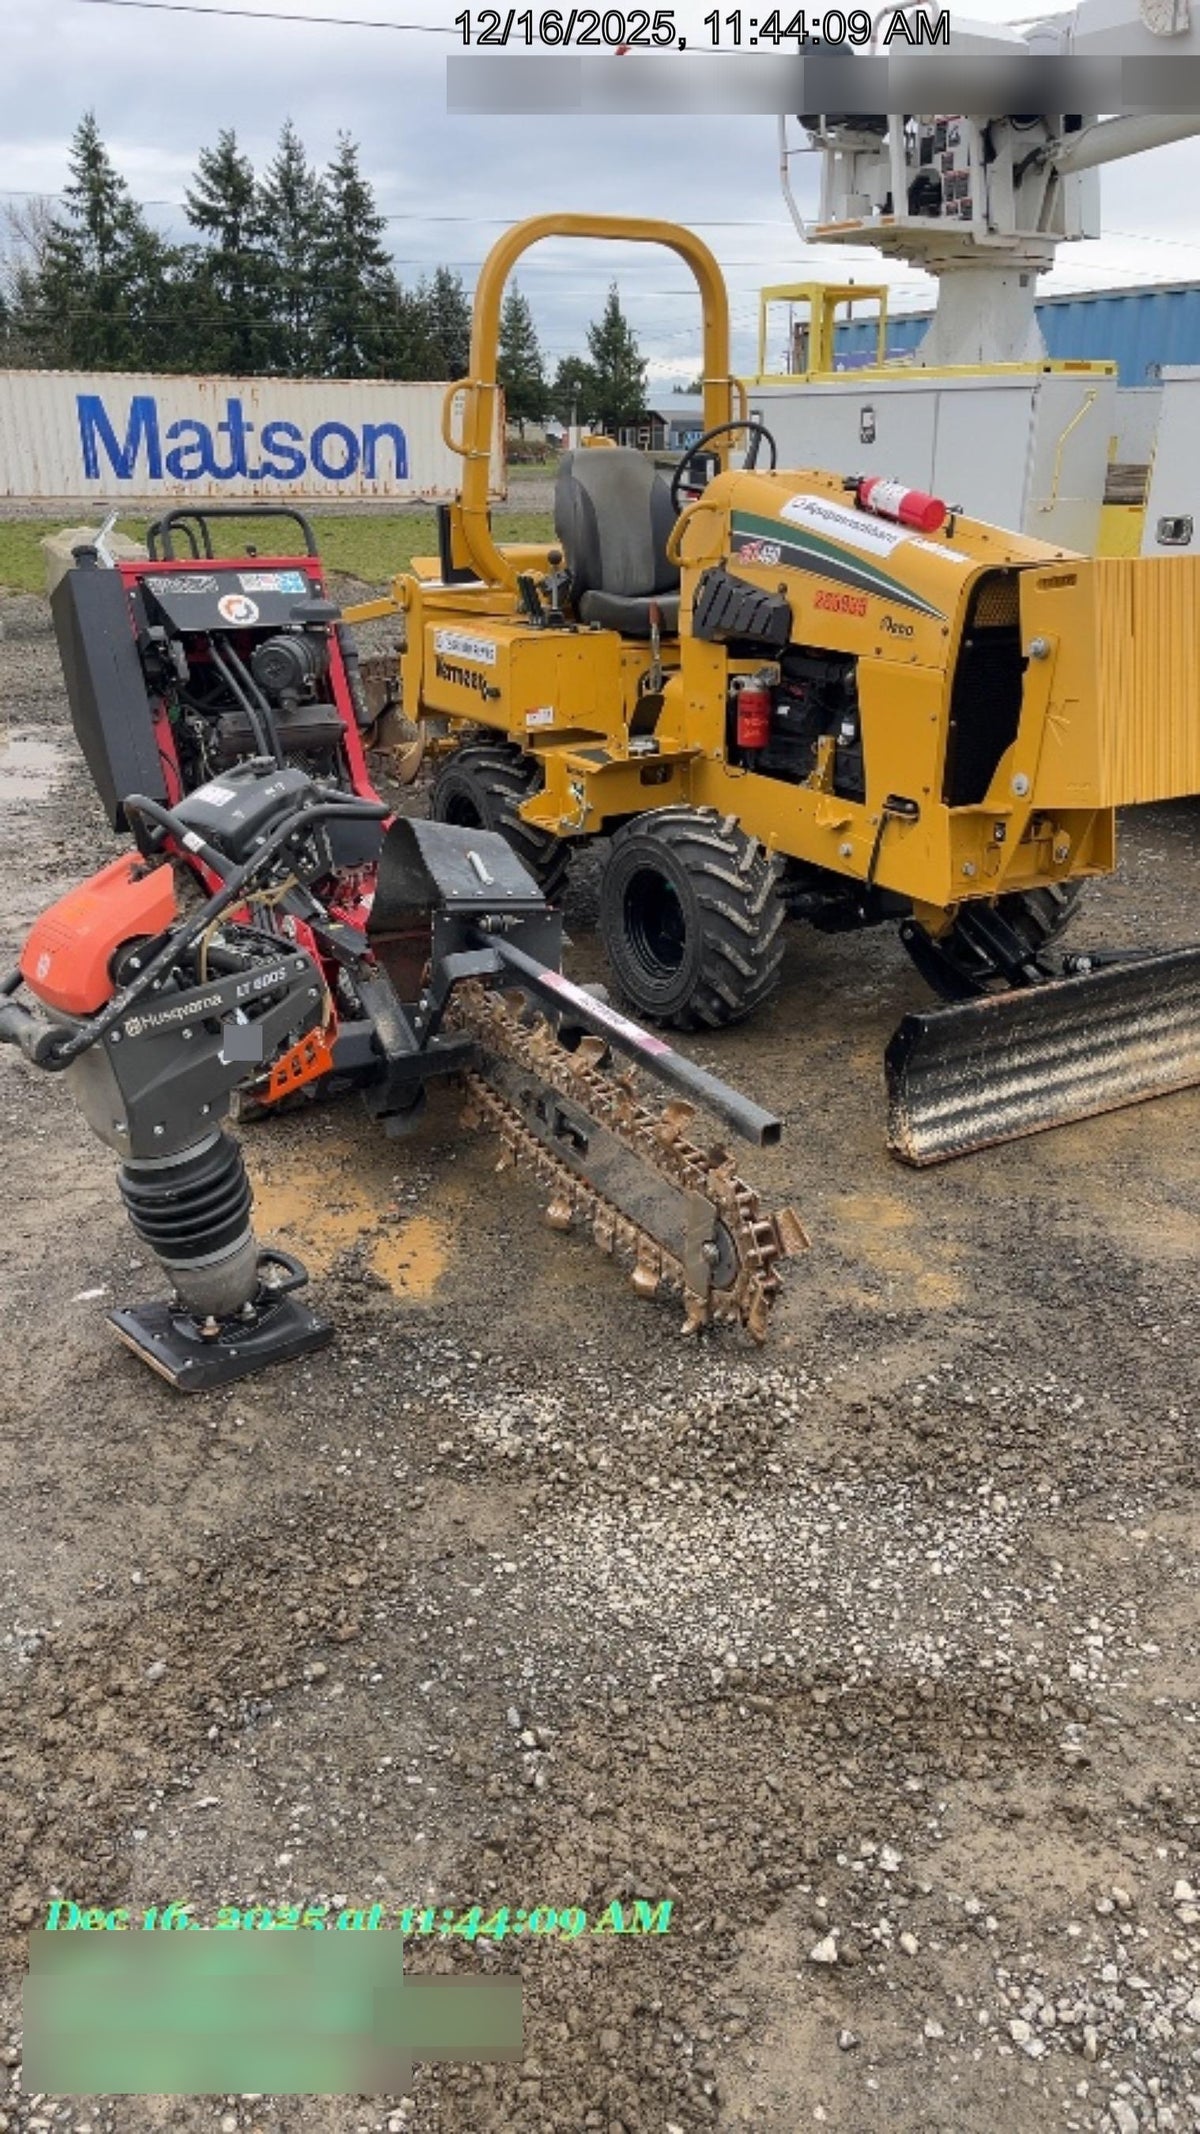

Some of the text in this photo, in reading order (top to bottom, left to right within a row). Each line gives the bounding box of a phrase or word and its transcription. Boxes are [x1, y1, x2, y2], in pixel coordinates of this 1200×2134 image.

[76, 394, 409, 480] Matson
[141, 993, 223, 1029] Husqvarna
[236, 982, 250, 999] LT
